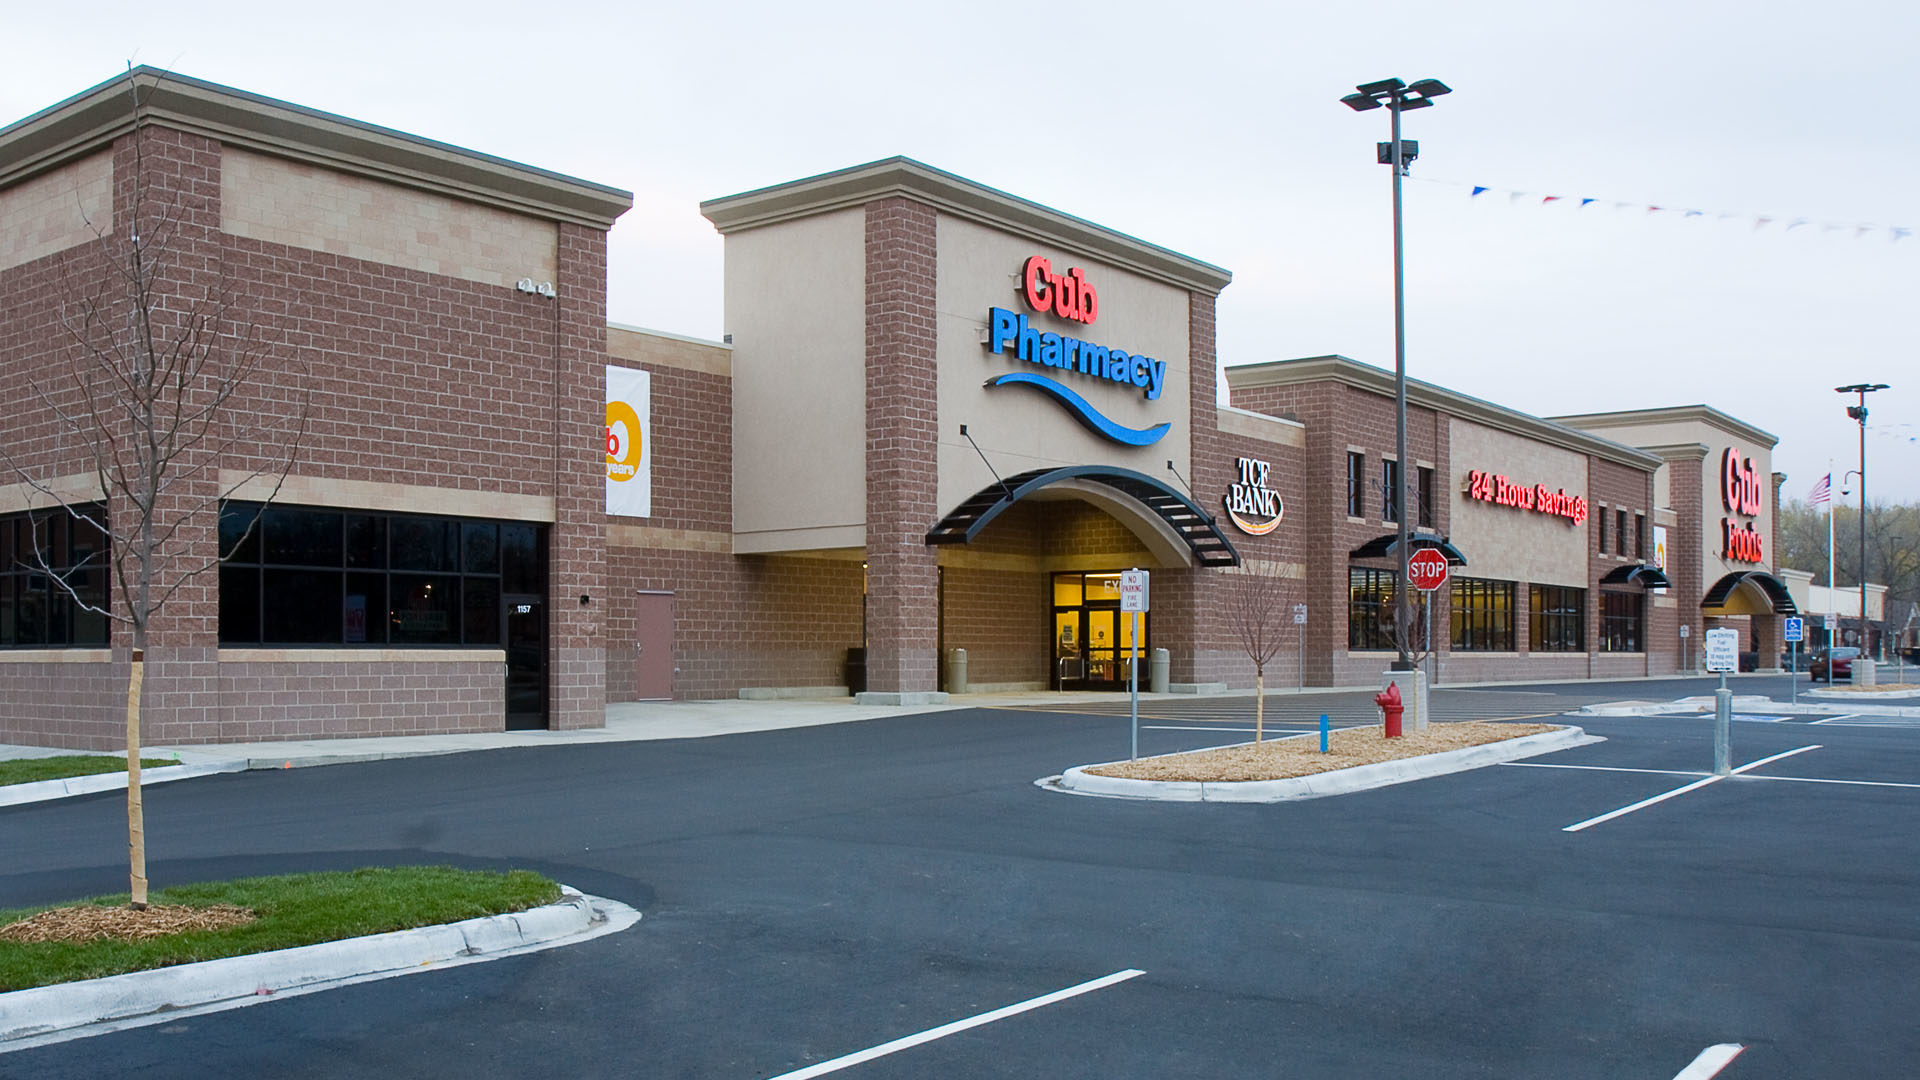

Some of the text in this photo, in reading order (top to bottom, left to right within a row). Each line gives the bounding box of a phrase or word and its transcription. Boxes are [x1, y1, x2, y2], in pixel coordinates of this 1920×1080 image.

[1023, 255, 1098, 325] Cub
[989, 307, 1166, 400] Pharmacy
[1238, 457, 1271, 488] TCF
[1723, 447, 1762, 517] Cub
[1231, 484, 1277, 517] BANK
[1470, 469, 1588, 527] 24 Hour Savings
[1723, 518, 1762, 563] Foods
[1104, 580, 1122, 593] EXI
[1411, 562, 1445, 578] STOP
[517, 605, 531, 613] 1157
